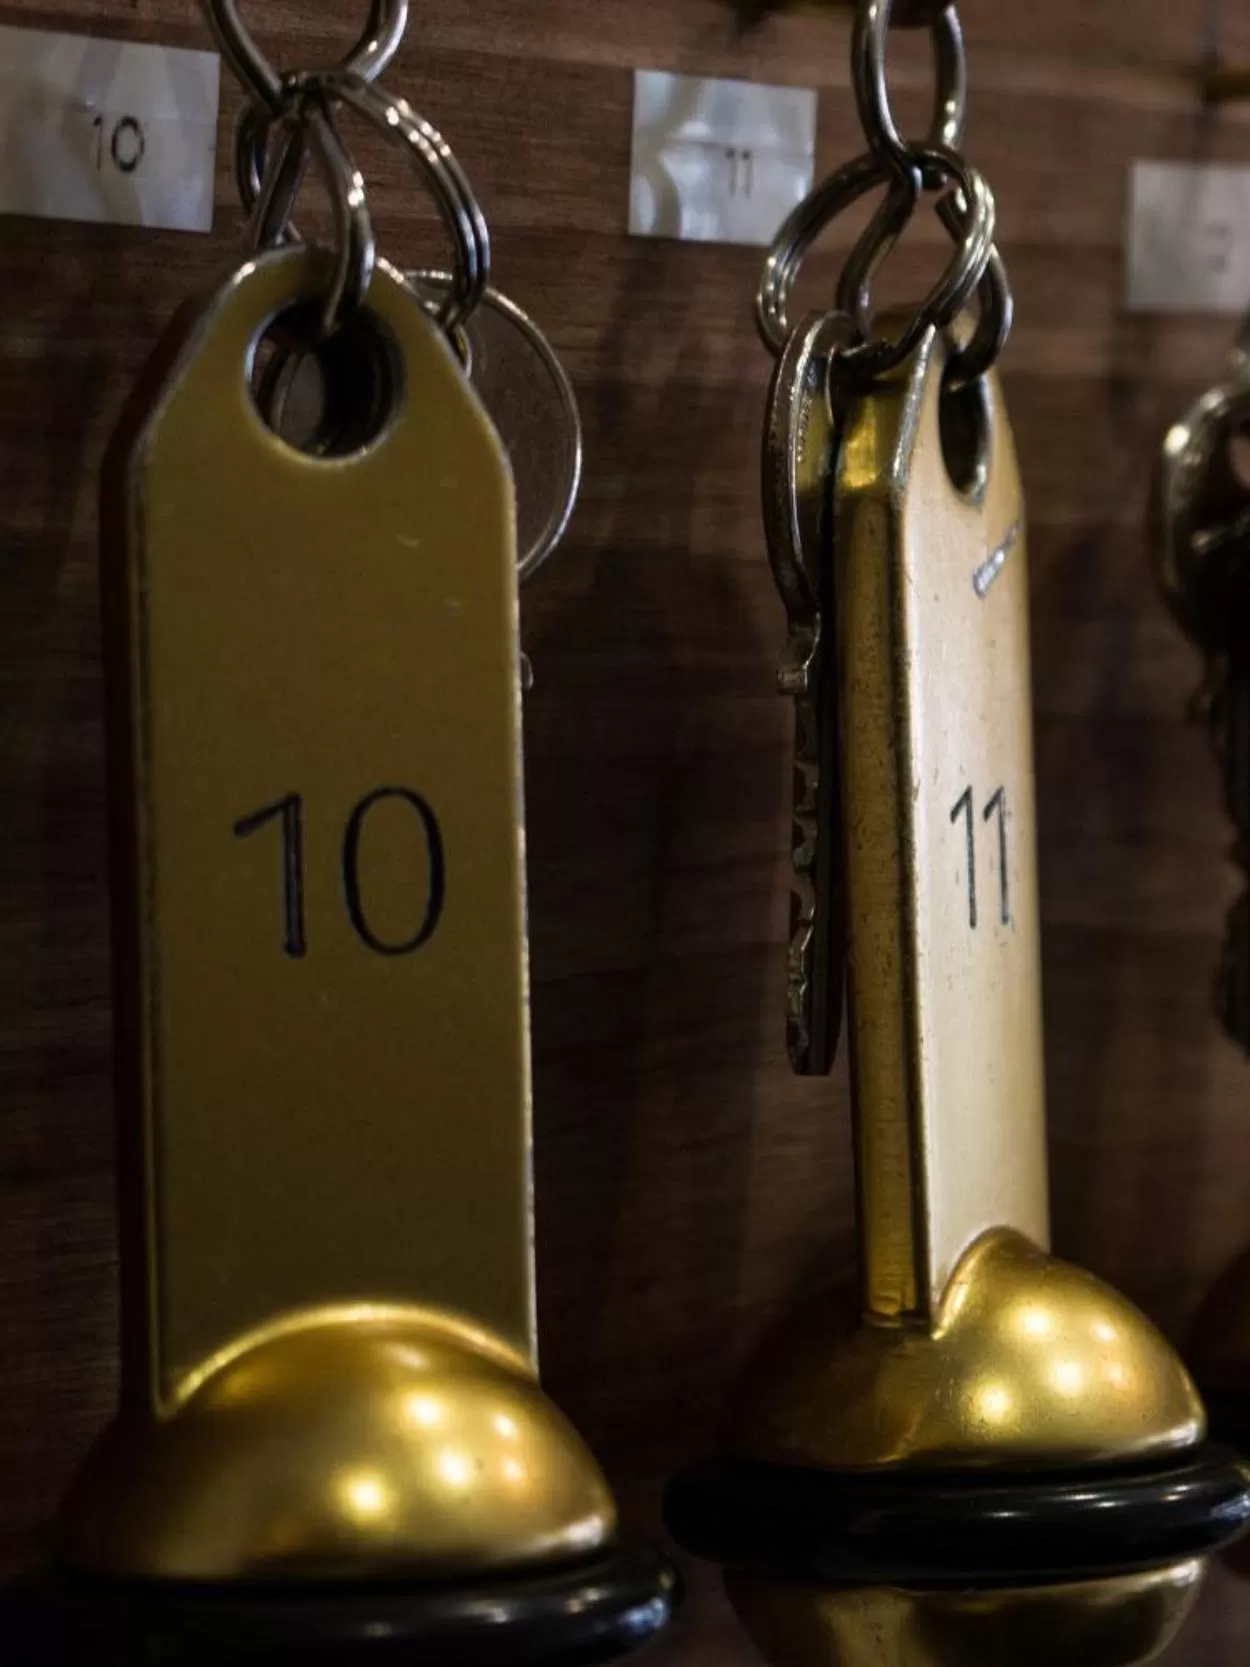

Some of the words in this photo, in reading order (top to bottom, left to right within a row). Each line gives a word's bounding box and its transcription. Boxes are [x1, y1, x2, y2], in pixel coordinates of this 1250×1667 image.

[92, 115, 145, 173] 10
[725, 147, 754, 199] 11
[232, 784, 447, 959] 10
[949, 784, 1011, 931] 11
